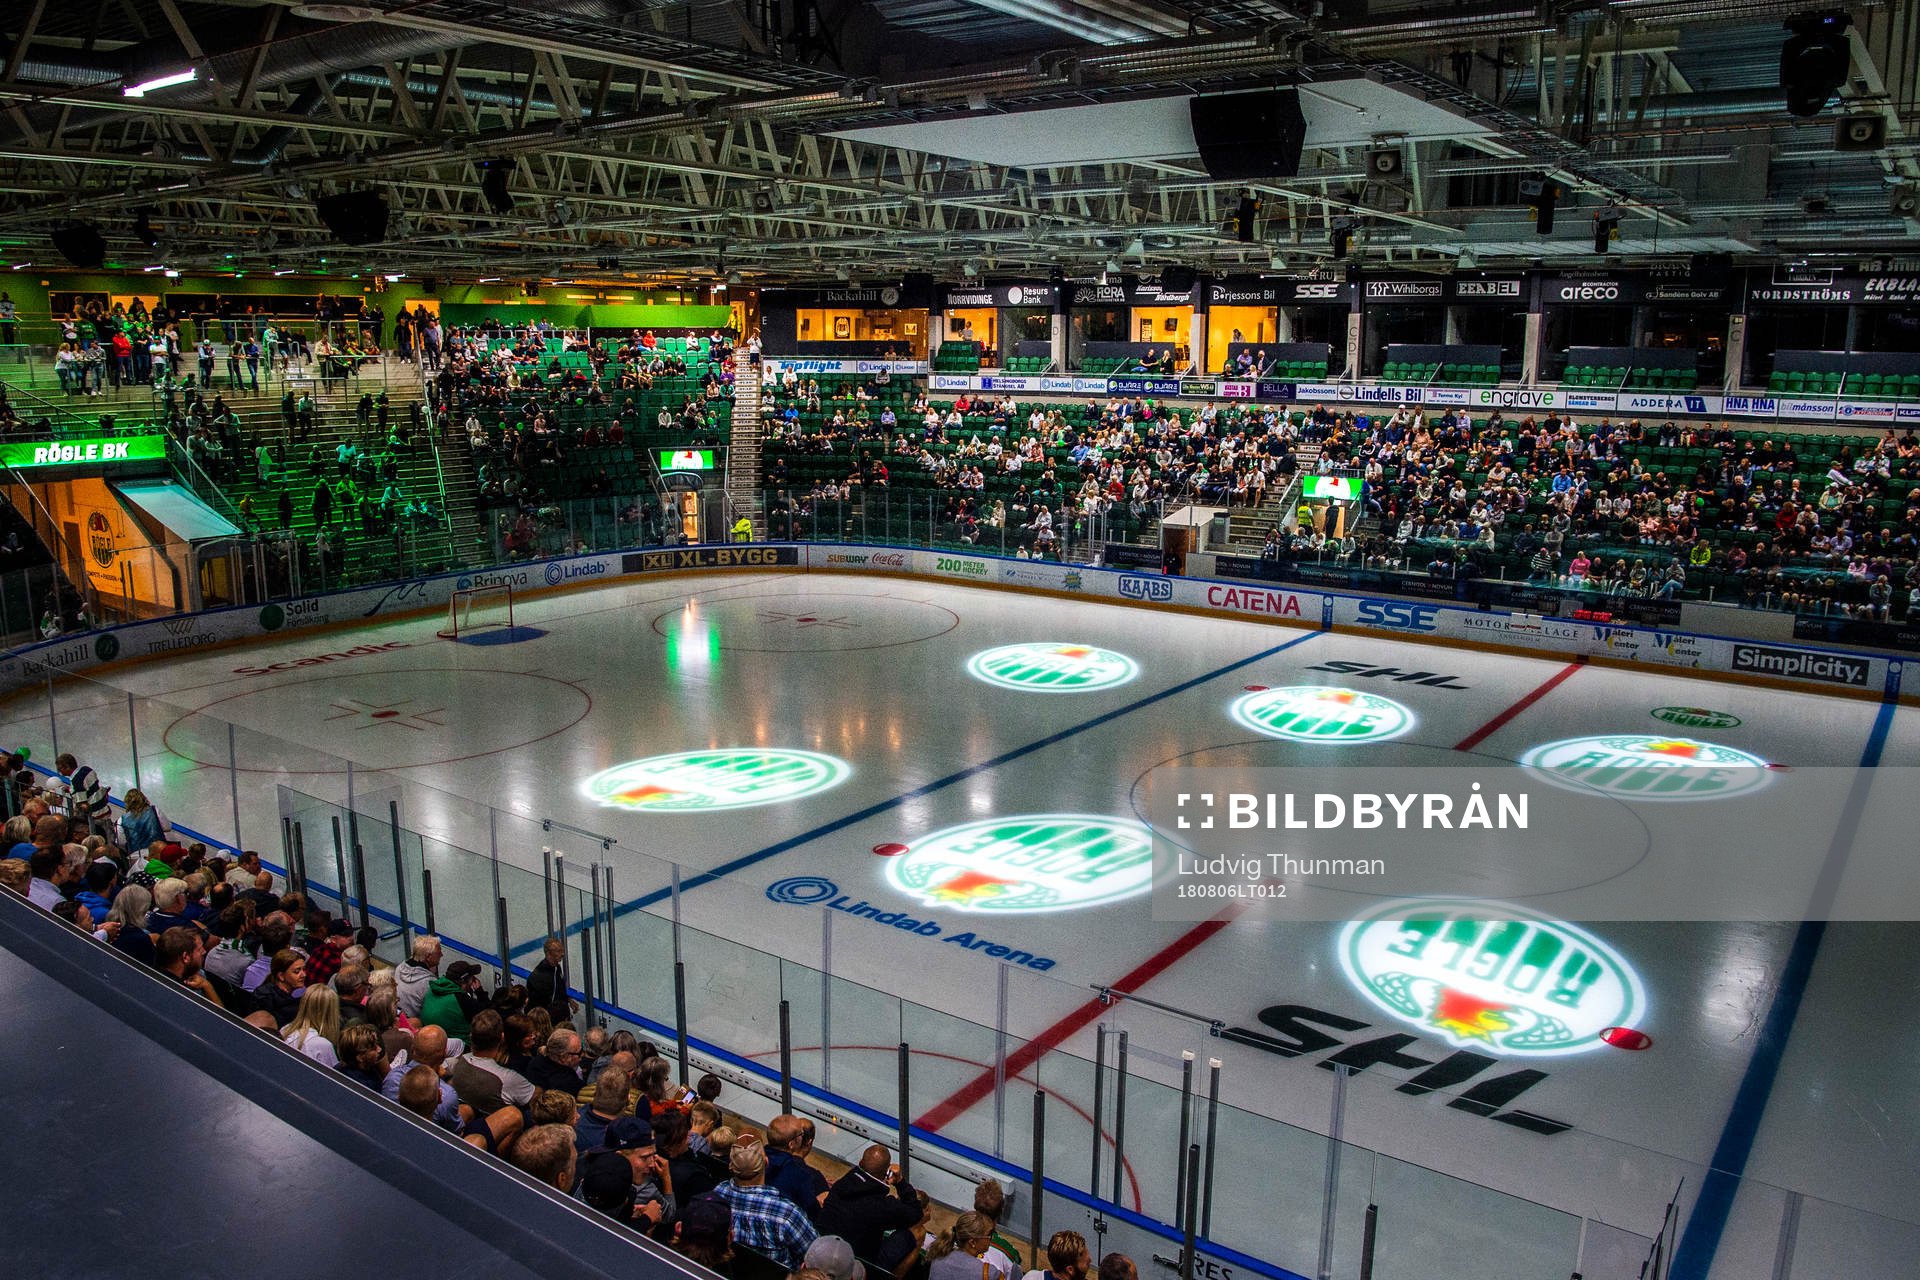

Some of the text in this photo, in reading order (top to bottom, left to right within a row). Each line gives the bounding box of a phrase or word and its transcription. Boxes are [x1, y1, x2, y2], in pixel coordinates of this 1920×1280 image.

[1023, 287, 1048, 295] Resurs
[1294, 284, 1339, 298] SSE
[1392, 284, 1440, 296] Wihlborgs
[1864, 278, 1920, 292] EKBLA
[827, 290, 876, 301] Backahill
[1023, 296, 1041, 304] Bank
[1264, 290, 1275, 299] Bil
[1560, 287, 1618, 299] areco
[1752, 288, 1851, 301] NORDSTRÖMS
[762, 316, 768, 325] E
[1349, 326, 1357, 337] C
[869, 363, 891, 371] Lindab
[1051, 380, 1072, 388] Lindab
[1084, 382, 1105, 390] Lindab
[1263, 384, 1289, 392] BELLA
[1298, 386, 1336, 395] Jakobssons
[1355, 387, 1421, 401] Lindells Bil
[1480, 390, 1554, 407] engrave
[1631, 398, 1702, 409] ADDERA IT
[1725, 397, 1775, 410] HNA HNA
[34, 441, 129, 464] RÖGLE BK
[648, 554, 672, 569] XL
[679, 549, 778, 567] XL-BYGG
[827, 554, 867, 563] SUBWAY
[936, 557, 962, 572] 200
[963, 560, 985, 570] METER
[564, 562, 605, 578] Lindab
[963, 567, 989, 576] HOCKEY
[474, 571, 528, 589] Brinova
[1122, 578, 1169, 597] KAABS
[286, 599, 319, 616] Solid
[1207, 586, 1301, 616] CATENA
[1355, 599, 1441, 632] SSE
[1463, 618, 1511, 631] MOTOR
[148, 631, 217, 655] TRELLEBORG
[22, 643, 89, 677] Backahill
[233, 640, 411, 677] Scandic
[1737, 648, 1863, 684] Simplicity.
[1304, 661, 1470, 690] SHL
[827, 895, 1057, 972] Lindab Arena
[1220, 1005, 1573, 1136] SHL
